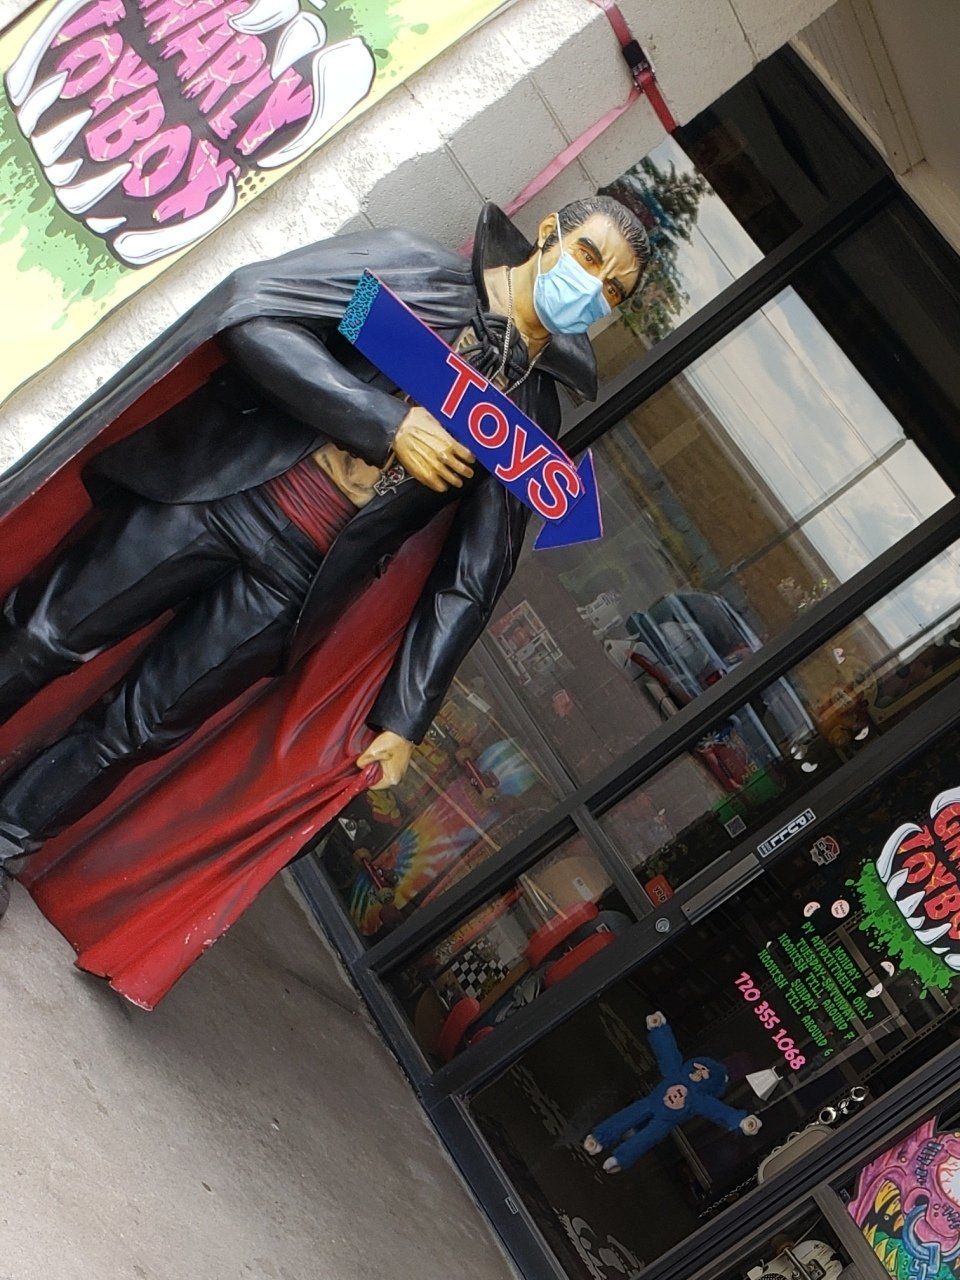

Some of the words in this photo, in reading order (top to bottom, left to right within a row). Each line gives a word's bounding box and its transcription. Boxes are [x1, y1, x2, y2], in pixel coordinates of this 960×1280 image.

[769, 814, 808, 848] PULL
[652, 885, 668, 903] yelp
[757, 948, 788, 988] NOONISH
[784, 988, 804, 1014] TILL
[801, 1014, 828, 1047] AROUND
[778, 933, 809, 973] NOONISH
[804, 972, 824, 998] TILL
[822, 998, 848, 1031] AROUND
[790, 979, 818, 1012] SUNDAY
[795, 938, 856, 1021] TUESDAY-SATURDAY
[801, 921, 815, 934] BY
[811, 935, 857, 996] APPOINTMENT
[852, 995, 873, 1020] ONLY
[832, 946, 861, 981] MONDAY
[733, 970, 762, 1003] 720
[753, 1000, 781, 1031] 355
[770, 1027, 808, 1071] 1068
